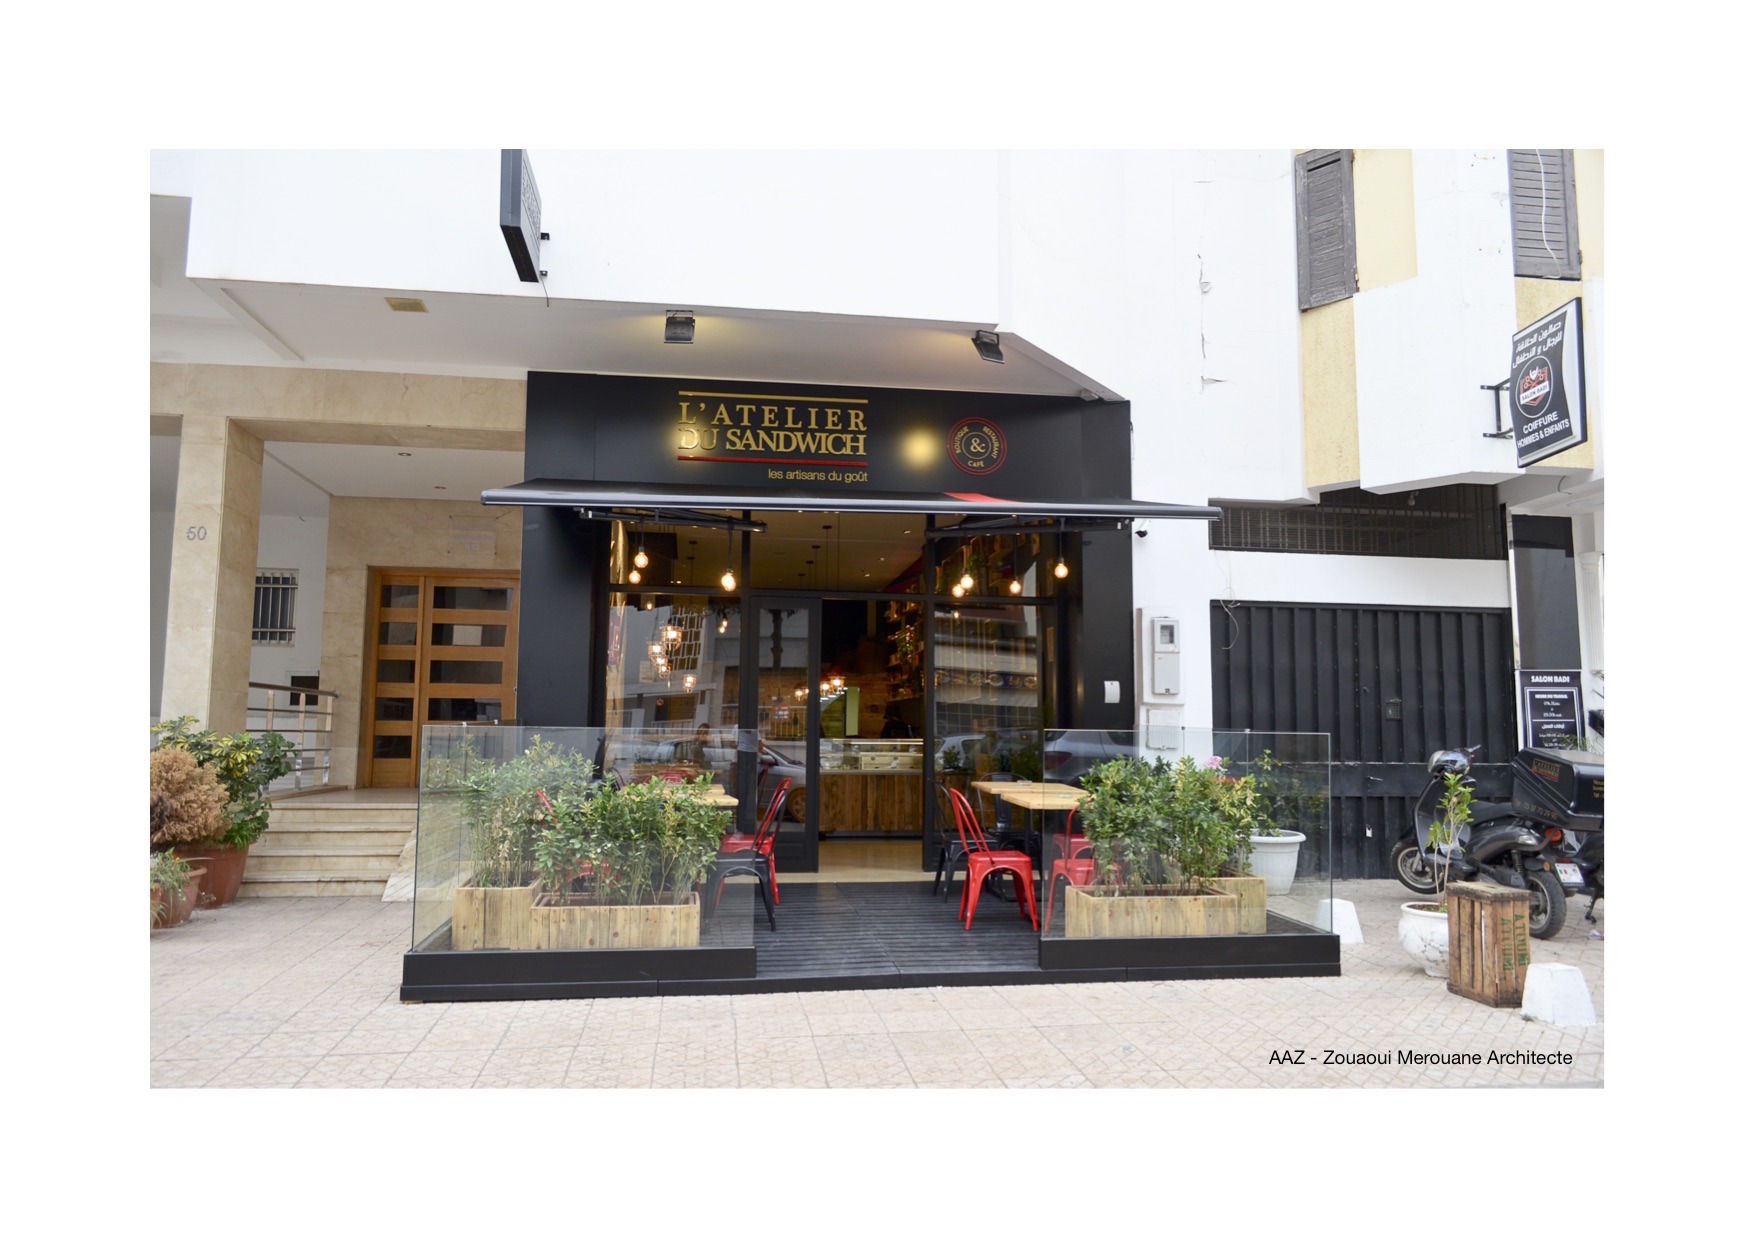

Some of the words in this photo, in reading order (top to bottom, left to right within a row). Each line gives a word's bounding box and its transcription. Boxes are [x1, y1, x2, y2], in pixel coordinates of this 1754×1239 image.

[1539, 322, 1562, 342] صالون
[678, 402, 867, 431] L'ATELIER
[1523, 411, 1559, 434] COIFFURE
[678, 428, 719, 451] DU
[725, 428, 867, 456] SANDWICH
[954, 426, 969, 454] BOUTIQUE
[982, 426, 1000, 459] RESTAURANT
[1517, 430, 1540, 448] HOMMES
[1544, 418, 1570, 437] ENFANTS
[768, 468, 783, 480] les
[785, 469, 825, 481] artisans
[828, 470, 842, 482] du
[844, 471, 868, 483] goût
[186, 526, 207, 541] 50
[1531, 675, 1553, 683] SALON
[1554, 675, 1570, 683] BADI
